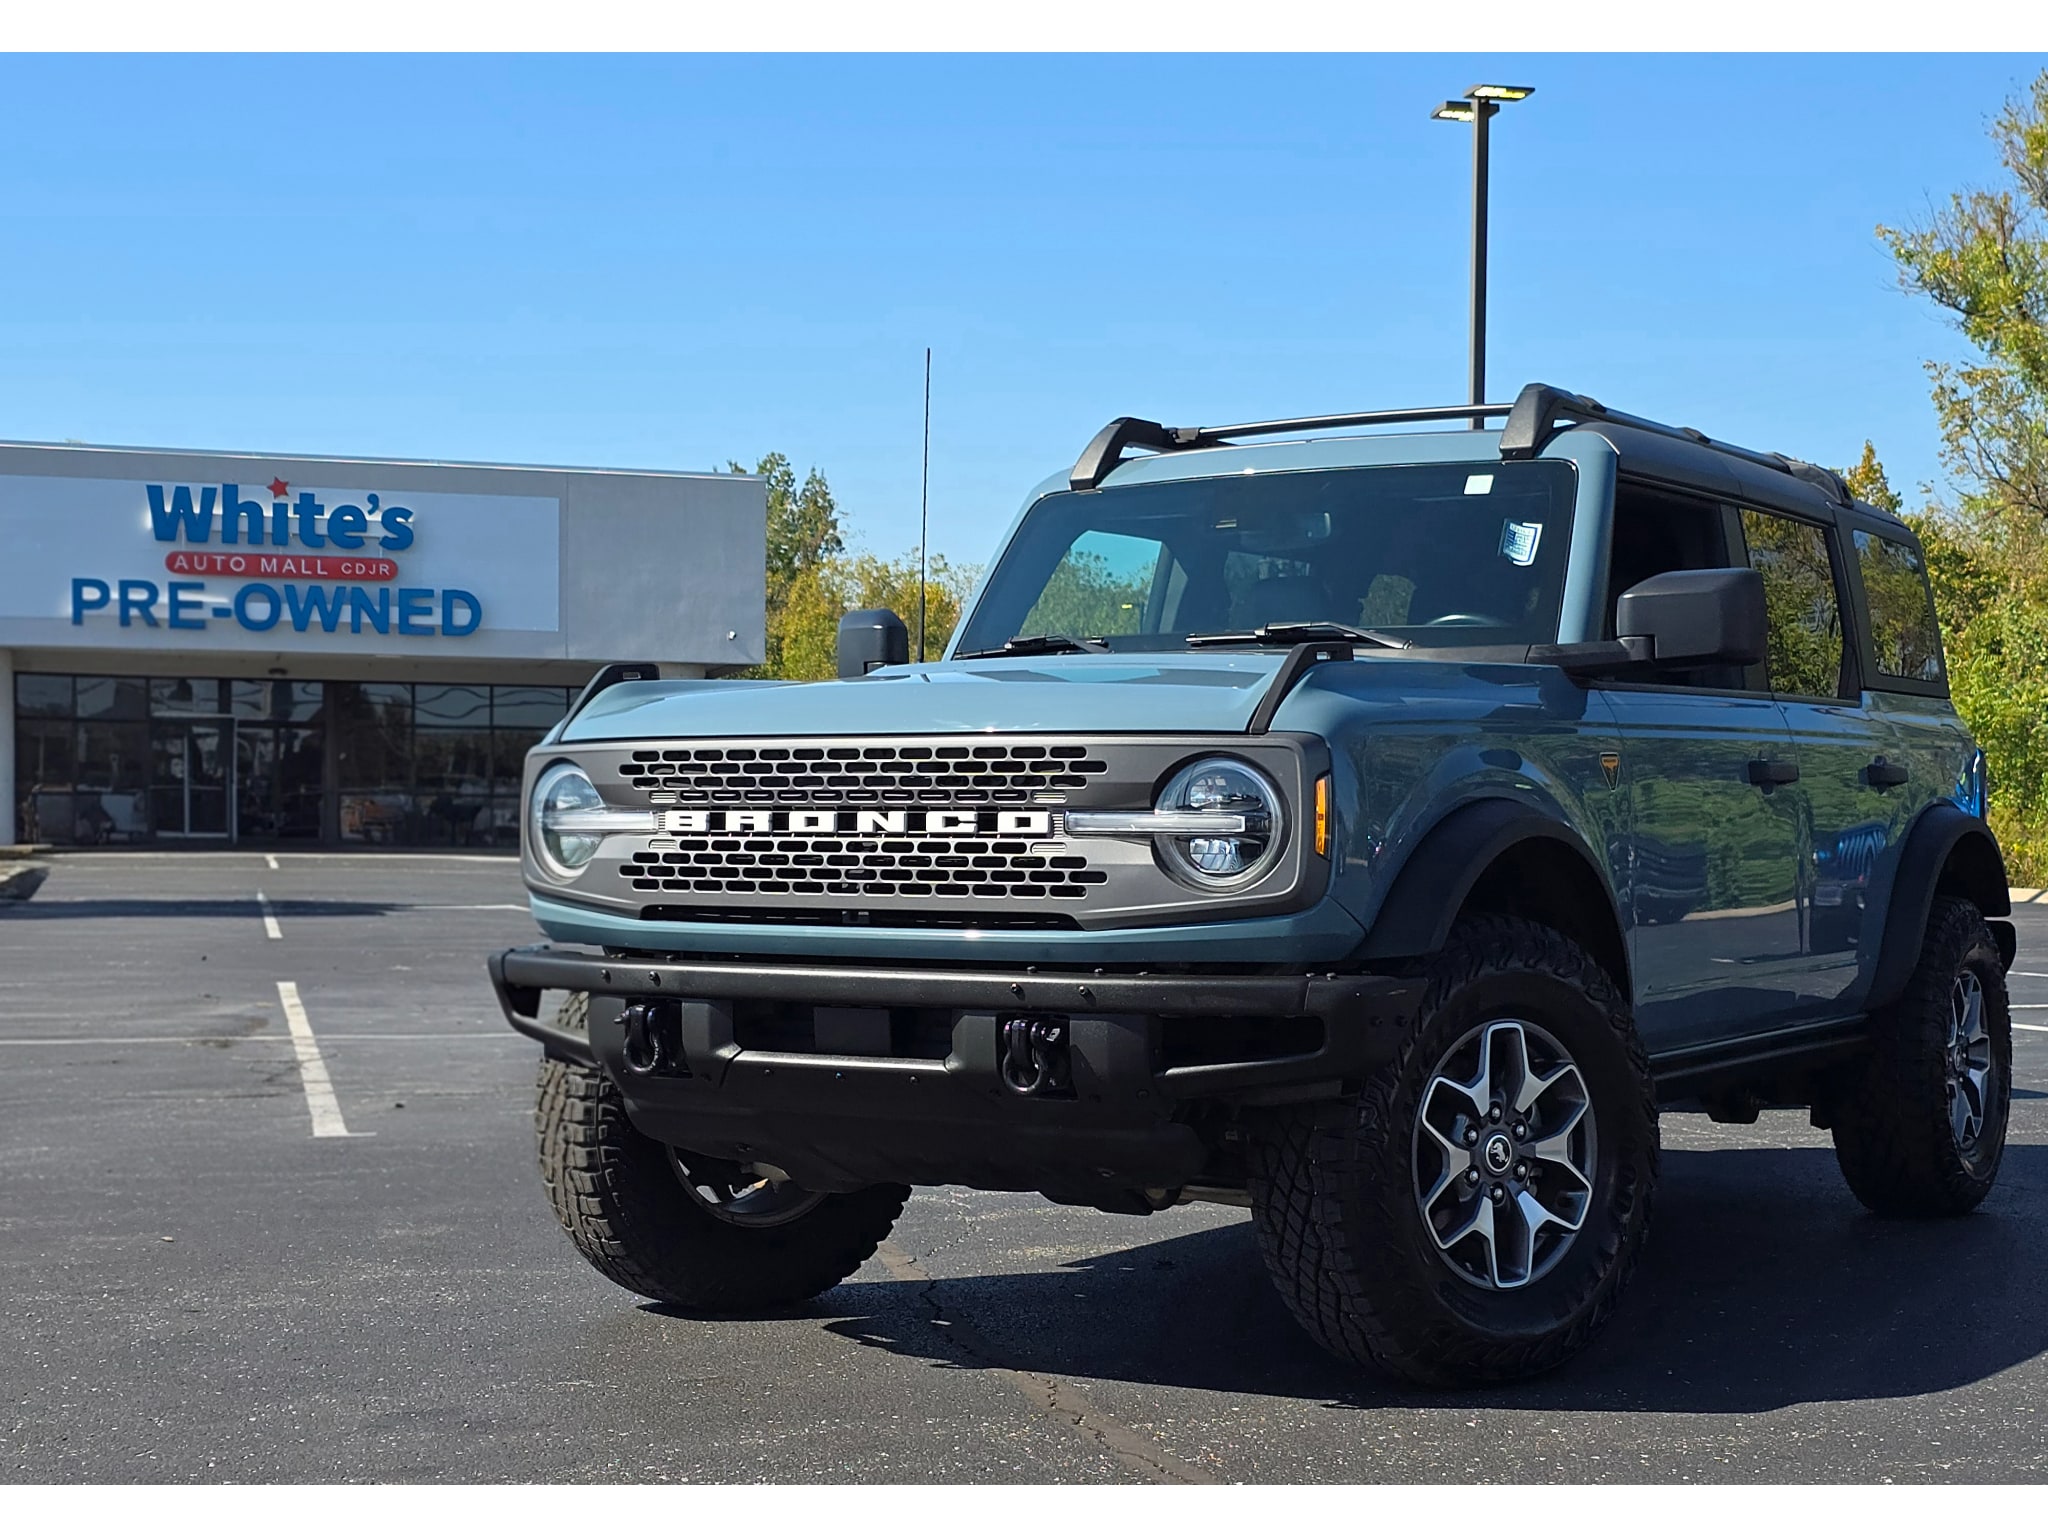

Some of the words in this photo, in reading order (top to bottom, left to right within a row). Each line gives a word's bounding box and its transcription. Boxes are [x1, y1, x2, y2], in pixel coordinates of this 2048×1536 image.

[146, 482, 415, 551] White's
[173, 555, 246, 573] AUTO
[260, 558, 328, 576] MALL
[341, 563, 391, 576] CDJR
[71, 578, 482, 636] PRE-OWNED
[665, 810, 1051, 834] BRONCO
